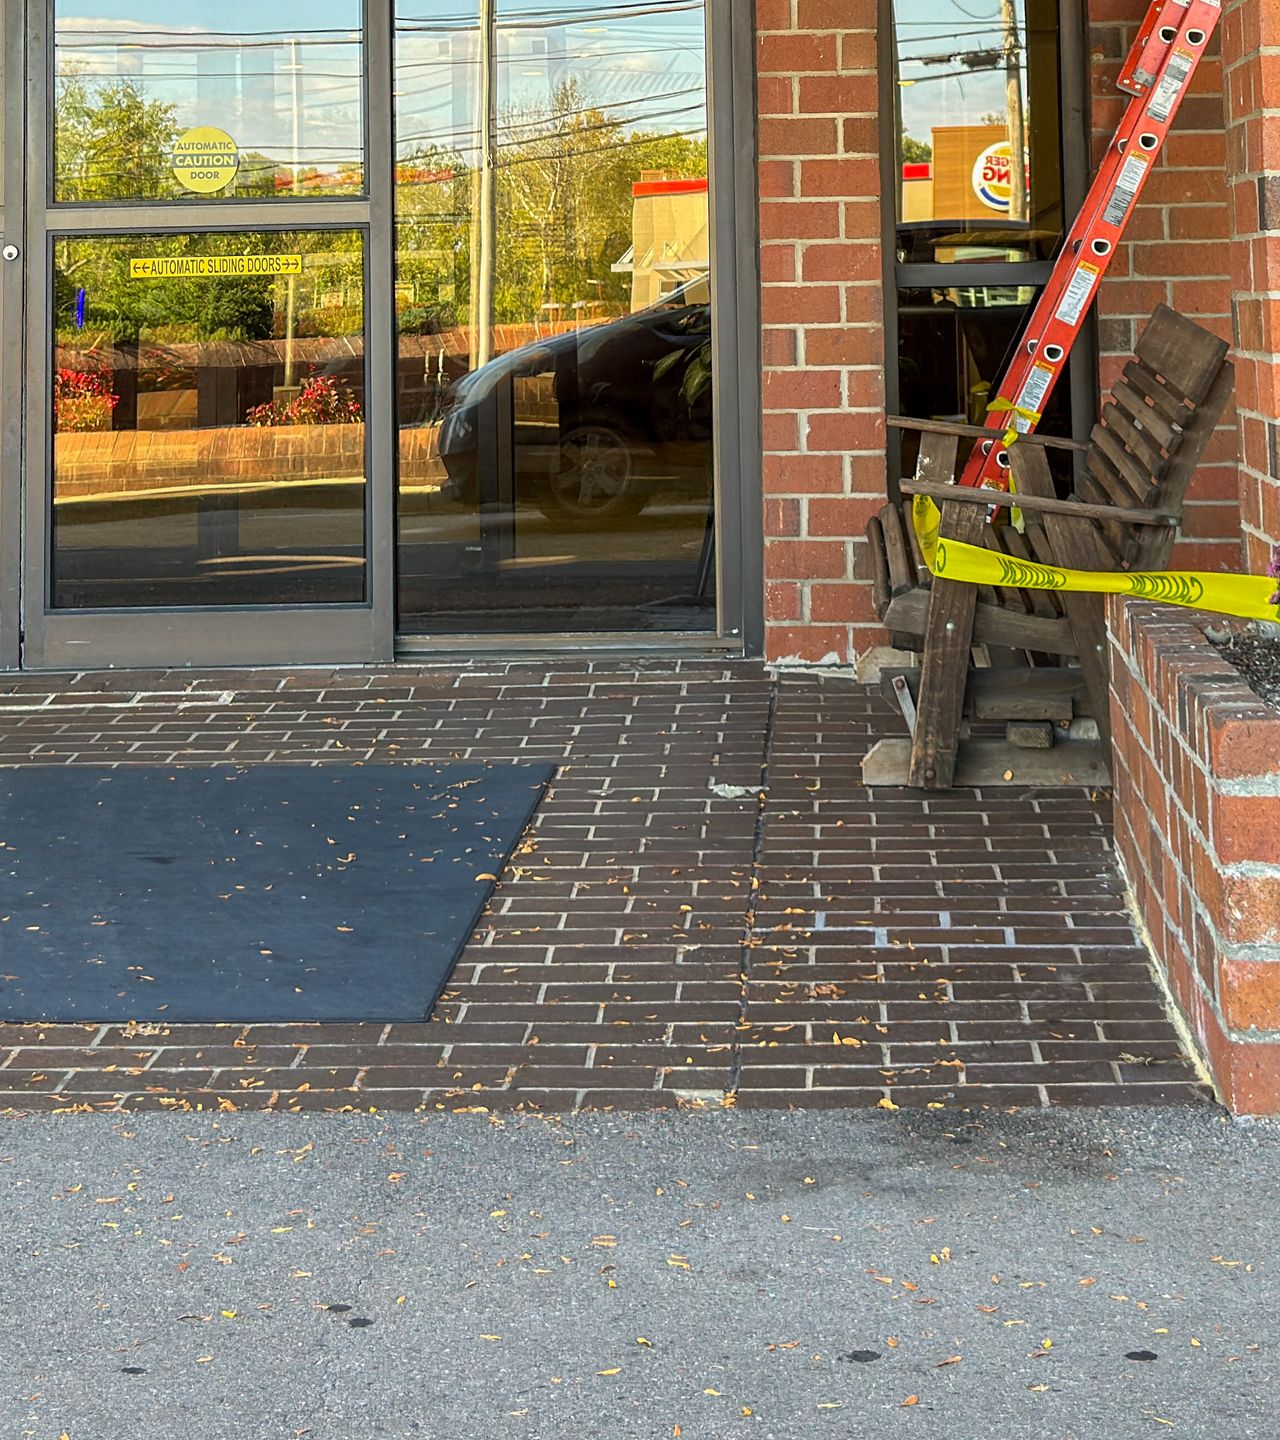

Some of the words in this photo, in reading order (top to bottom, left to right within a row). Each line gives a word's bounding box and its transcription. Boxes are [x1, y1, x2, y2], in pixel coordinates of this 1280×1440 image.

[177, 142, 232, 151] AUTOMATIC
[175, 155, 234, 166] CAUTION
[190, 171, 220, 180] DOOR
[150, 259, 205, 275] AUTOMATIC
[207, 258, 245, 274] SLIDING
[247, 257, 281, 272] DOORS
